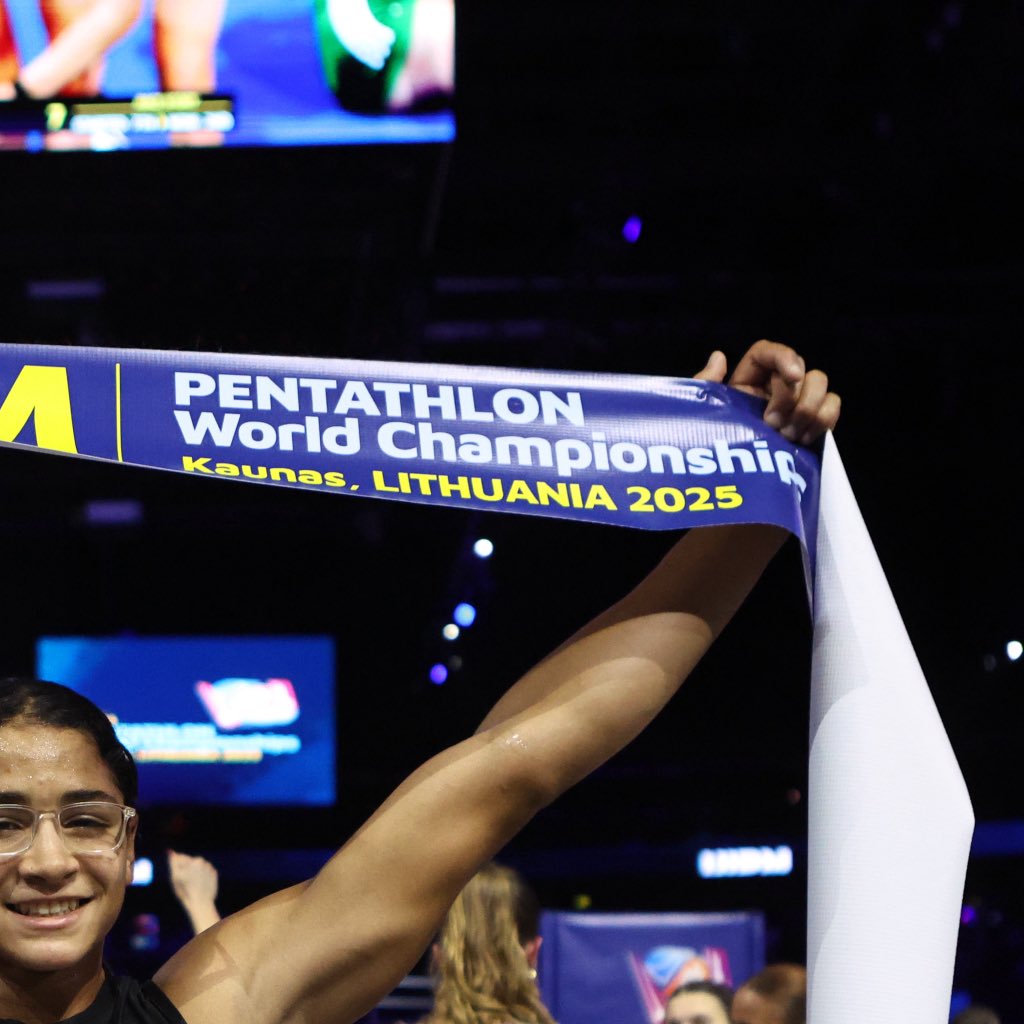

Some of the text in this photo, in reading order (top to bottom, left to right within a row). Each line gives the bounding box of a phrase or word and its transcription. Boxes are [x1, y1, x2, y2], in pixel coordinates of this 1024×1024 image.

[173, 371, 585, 427] PENTATHLON
[173, 410, 361, 455] World
[182, 457, 744, 512] Kaunas, LITHUANIA 2025
